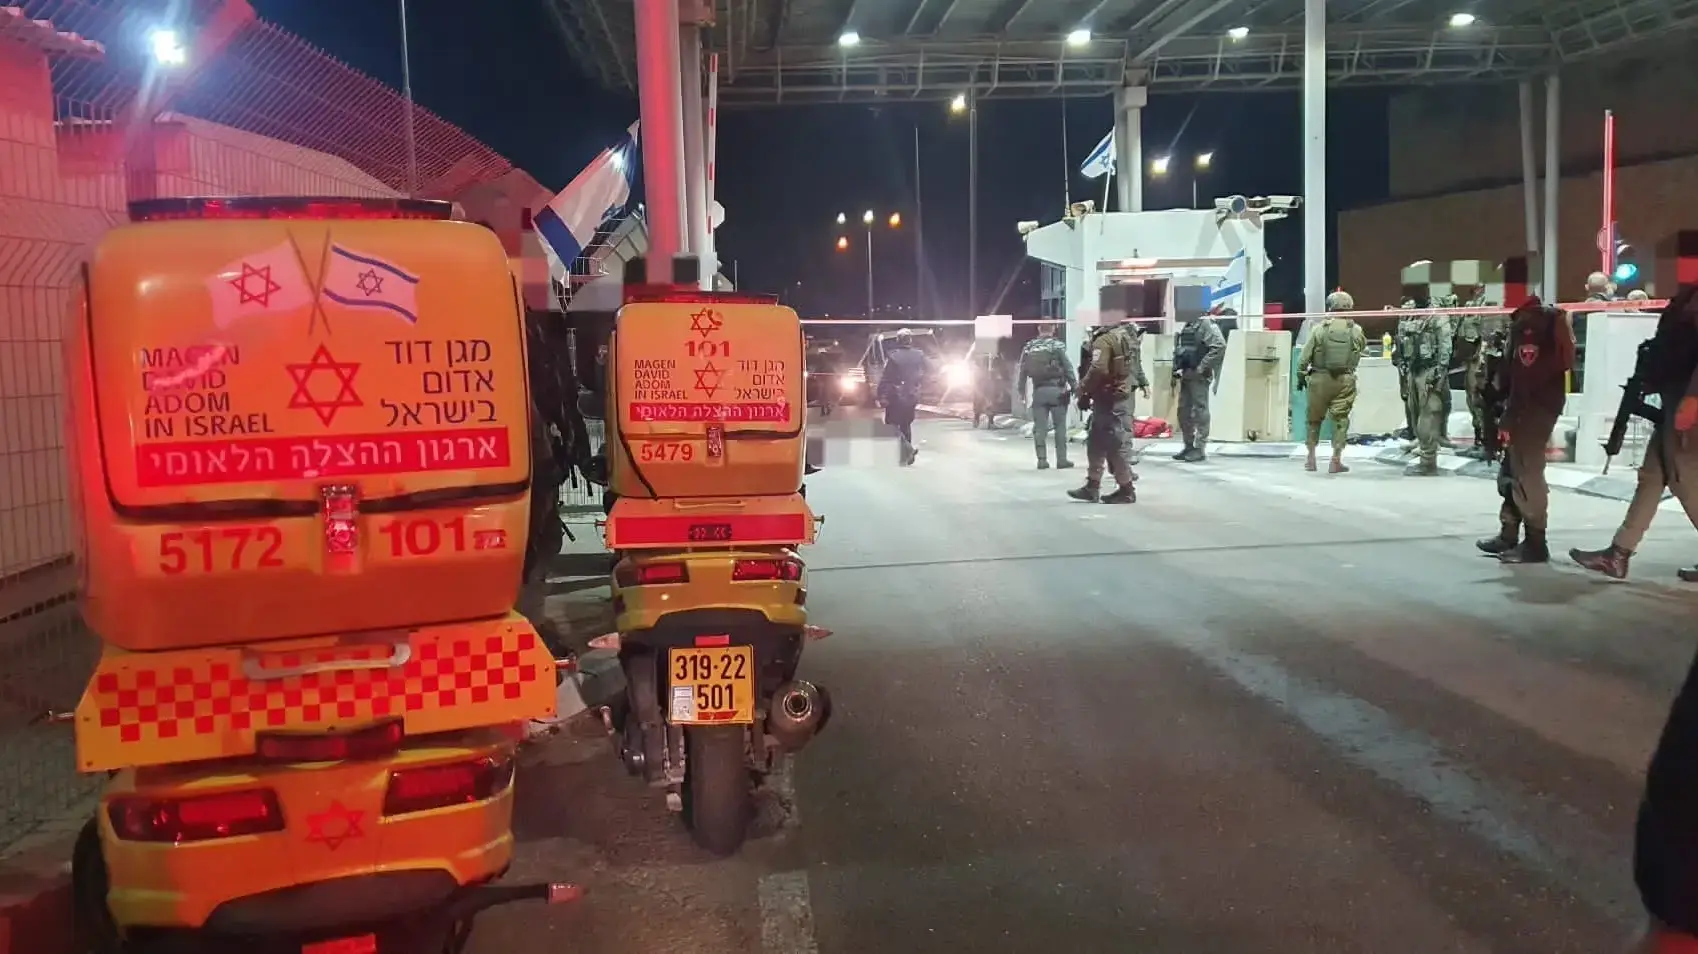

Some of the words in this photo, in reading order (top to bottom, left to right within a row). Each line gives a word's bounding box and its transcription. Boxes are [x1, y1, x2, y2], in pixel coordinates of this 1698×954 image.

[384, 340, 432, 364] דוד
[446, 339, 491, 368] מגן
[684, 340, 730, 358] 101
[634, 359, 676, 369] MAGEN
[634, 369, 670, 380] DAVID
[737, 360, 758, 372] דוד
[423, 369, 494, 394] אדום
[635, 380, 671, 390] ADOM
[752, 374, 785, 386] אדום
[144, 392, 231, 415] ADOM
[634, 390, 647, 400] IN
[650, 390, 688, 400] ISRAEL
[380, 398, 497, 427] בישראל
[144, 417, 174, 438] IN
[185, 412, 275, 437] ISRAEL
[150, 443, 274, 476] הלאומי
[291, 439, 402, 470] ההצלה
[416, 436, 498, 469] ארגון
[641, 443, 693, 461] 5479
[378, 516, 465, 557] 101
[159, 526, 284, 575] 5172
[697, 683, 734, 710] 501
